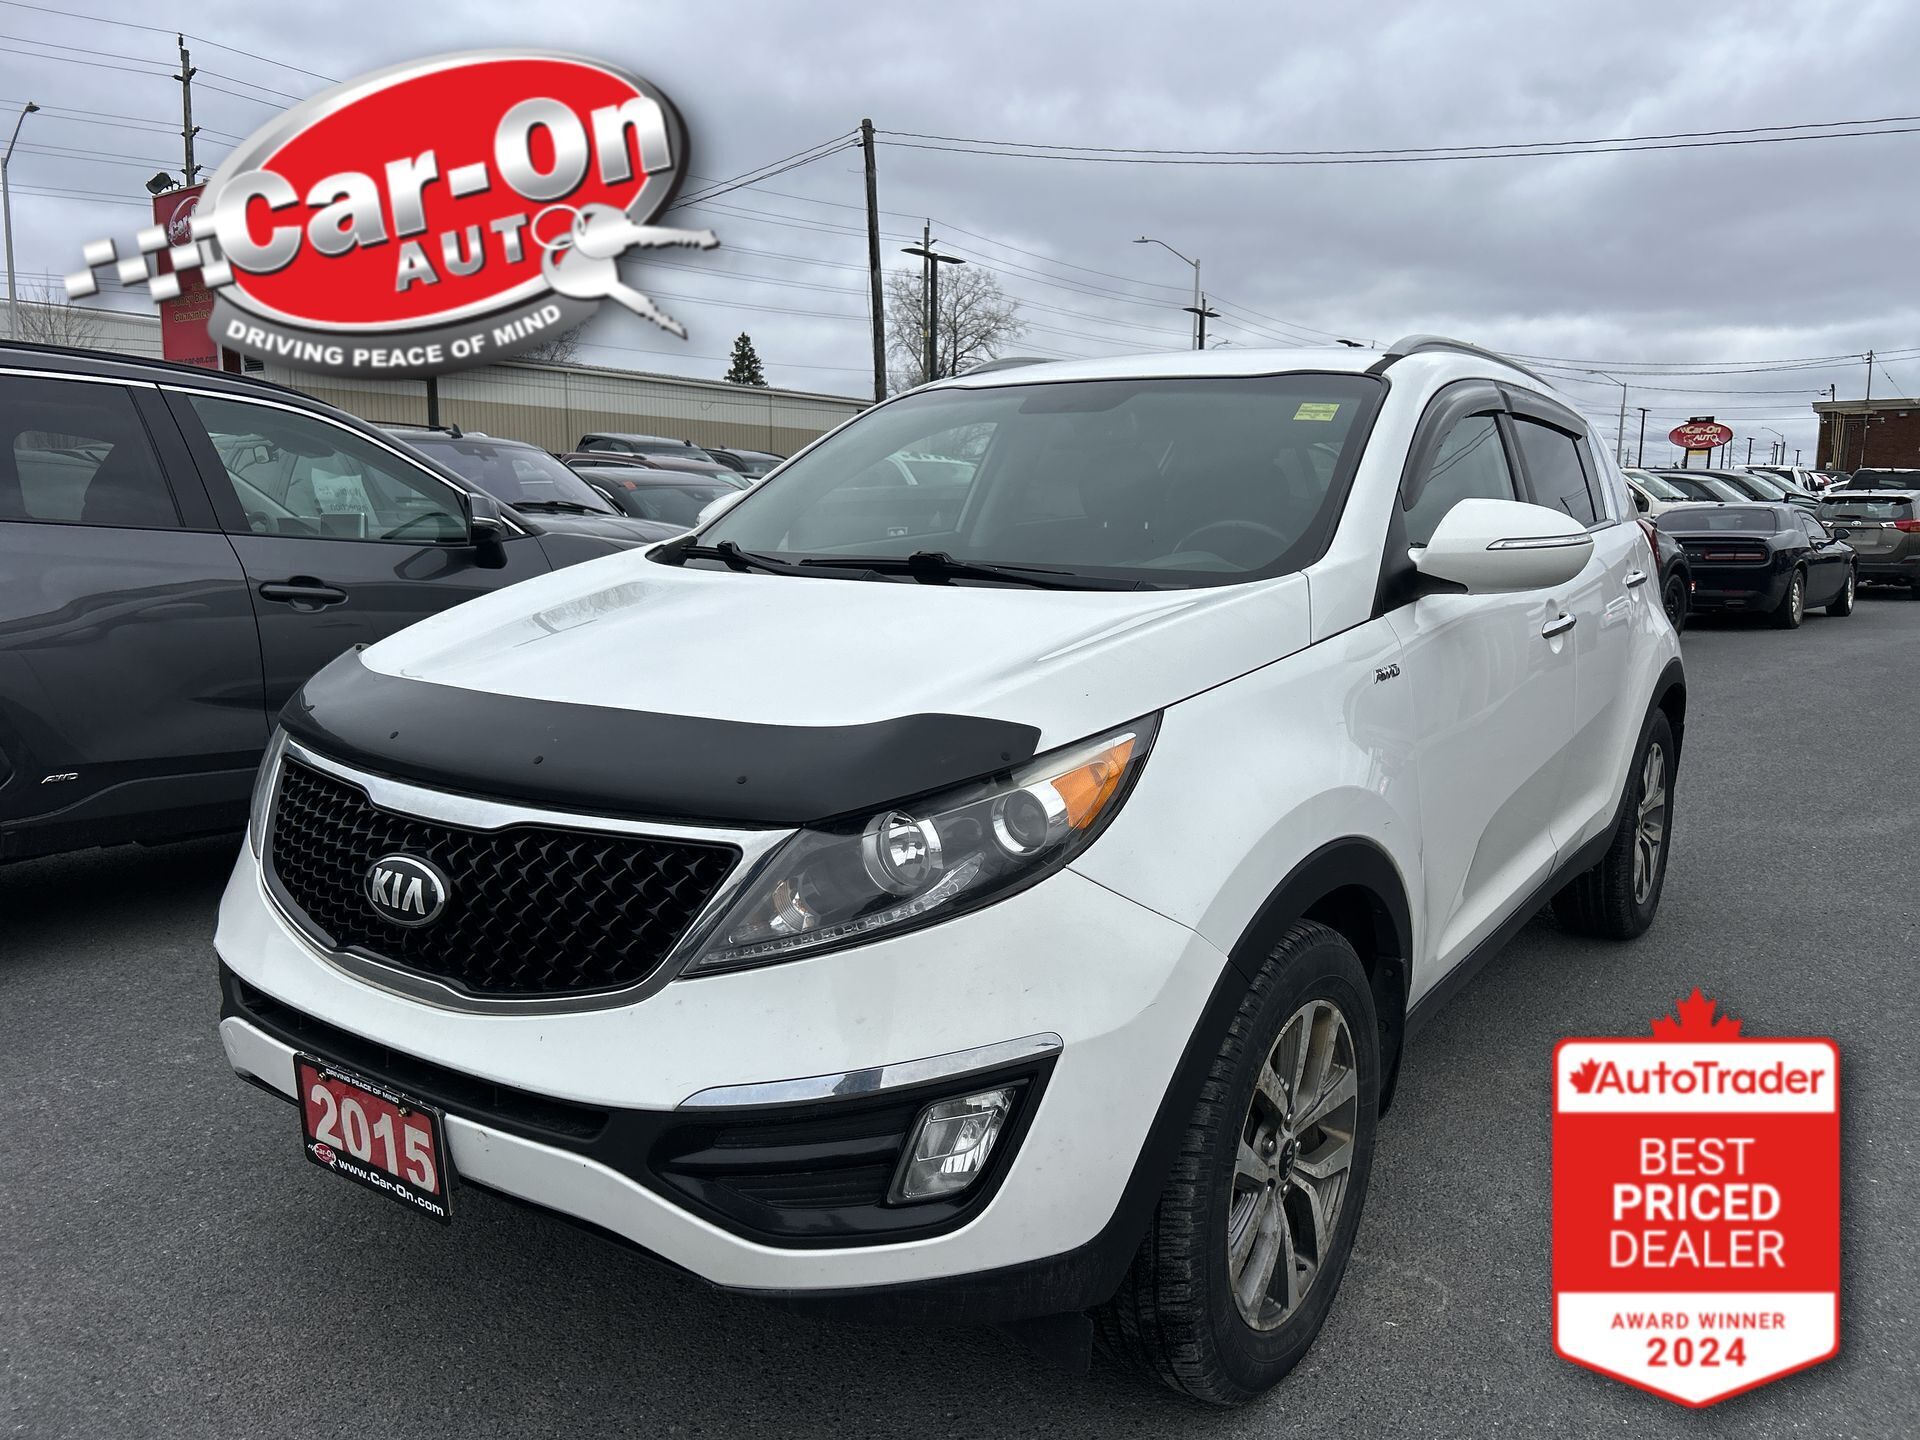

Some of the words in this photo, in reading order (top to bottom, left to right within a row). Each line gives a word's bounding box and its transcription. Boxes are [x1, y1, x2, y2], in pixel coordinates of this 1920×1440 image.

[1687, 425, 1721, 434] Car-On
[372, 867, 426, 915] KIA
[325, 1068, 351, 1083] DRIVING
[351, 1078, 372, 1092] PEACE
[372, 1087, 382, 1096] OF
[382, 1091, 400, 1104] MIND
[311, 1084, 436, 1193] 2015
[338, 1159, 444, 1217] www.Car-On.com
